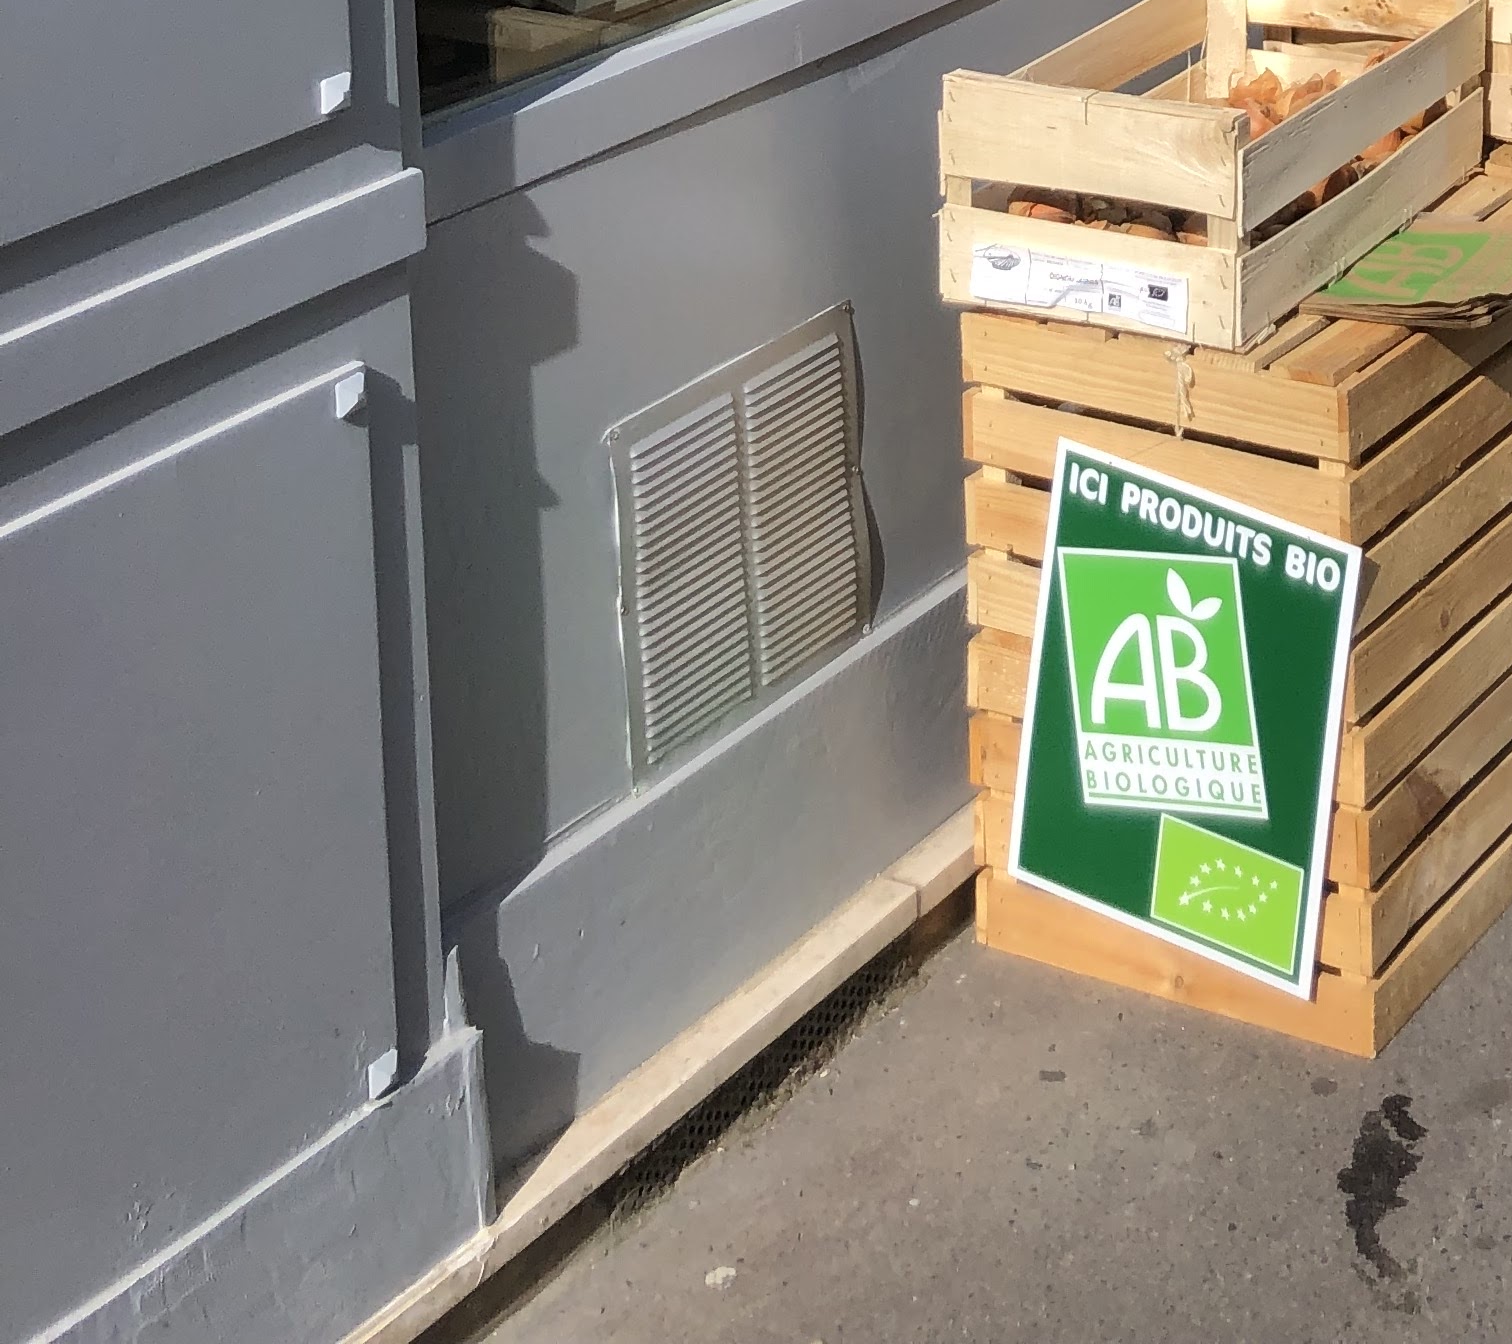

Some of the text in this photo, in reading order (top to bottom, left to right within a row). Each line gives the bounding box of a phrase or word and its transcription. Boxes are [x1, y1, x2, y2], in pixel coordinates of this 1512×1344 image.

[1068, 462, 1341, 592] ICI PRODUITS BIO
[1090, 612, 1223, 733] AB
[1084, 740, 1259, 775] AGRICULTURE
[1086, 769, 1262, 804] BIOLOGIQUE
